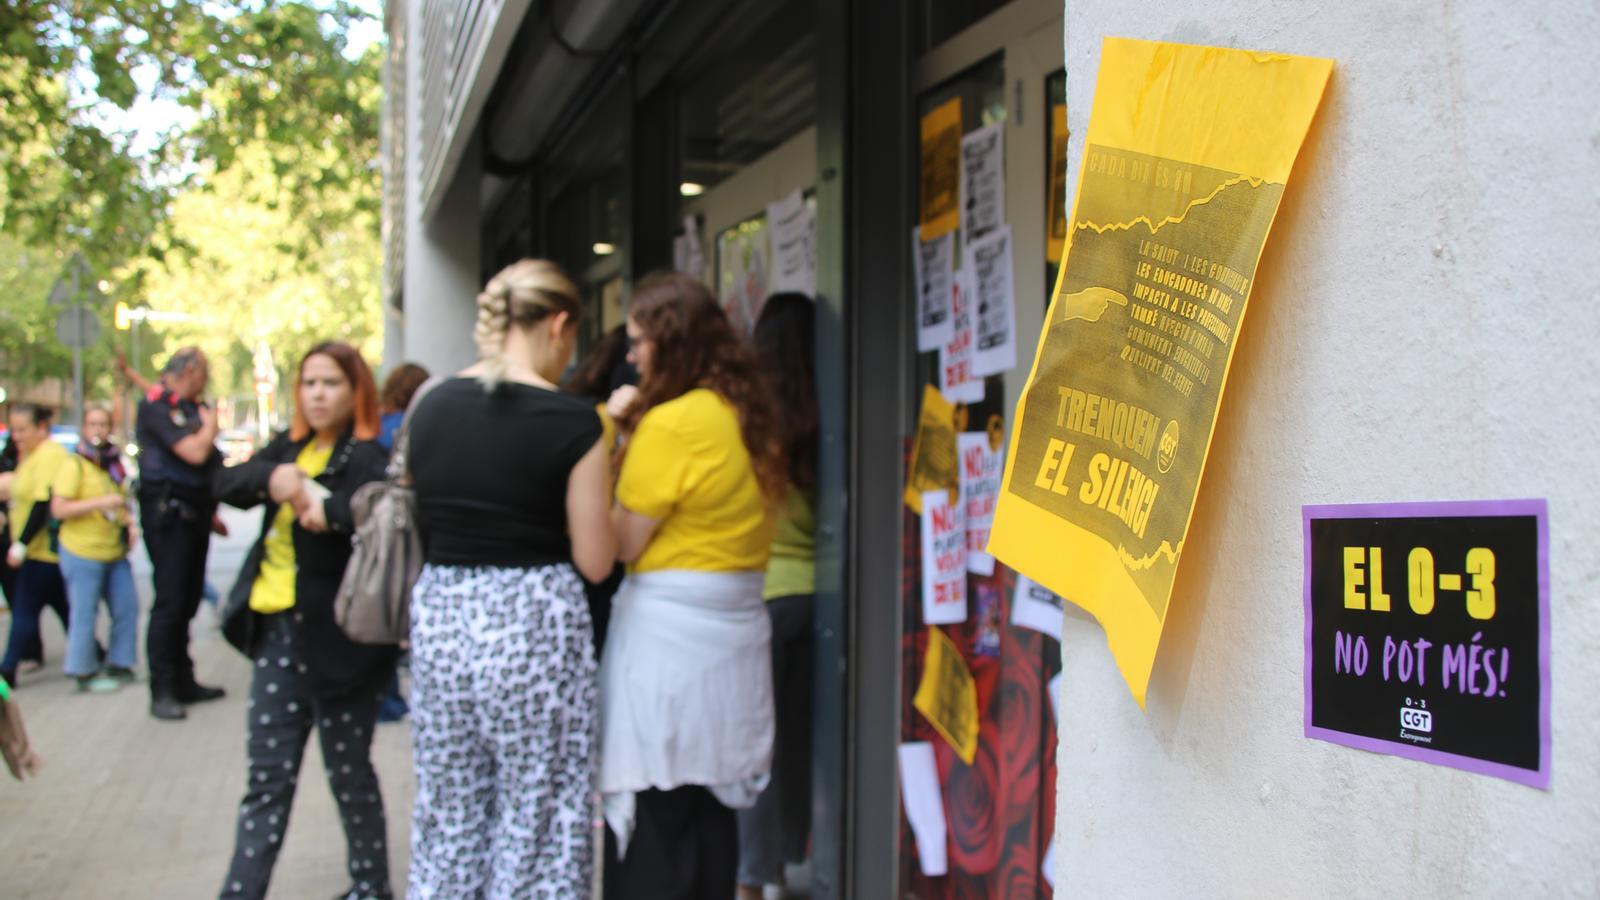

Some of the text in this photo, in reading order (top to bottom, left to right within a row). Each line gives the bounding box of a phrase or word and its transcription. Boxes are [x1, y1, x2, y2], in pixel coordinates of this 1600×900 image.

[1139, 239, 1150, 256] LA
[1151, 244, 1180, 265] SALUT
[1190, 256, 1208, 275] LES
[1136, 261, 1151, 278] LES
[1153, 267, 1208, 300] EDUCADORES
[1133, 282, 1169, 309] IMPACTA
[1170, 297, 1179, 312] A
[1180, 301, 1198, 320] LES
[1127, 324, 1174, 357] COMUNITAT
[1130, 303, 1159, 327] TAMBÉ
[1159, 315, 1190, 342] AFECTA
[1120, 344, 1162, 375] QUALITAT
[1057, 386, 1160, 460] TRENQUEM
[1035, 438, 1076, 497] EL
[1079, 453, 1160, 540] SILENCI
[1344, 547, 1496, 620] EL 0-3
[1335, 630, 1509, 698] NO POT MÉS!
[1403, 710, 1429, 729] CGT
